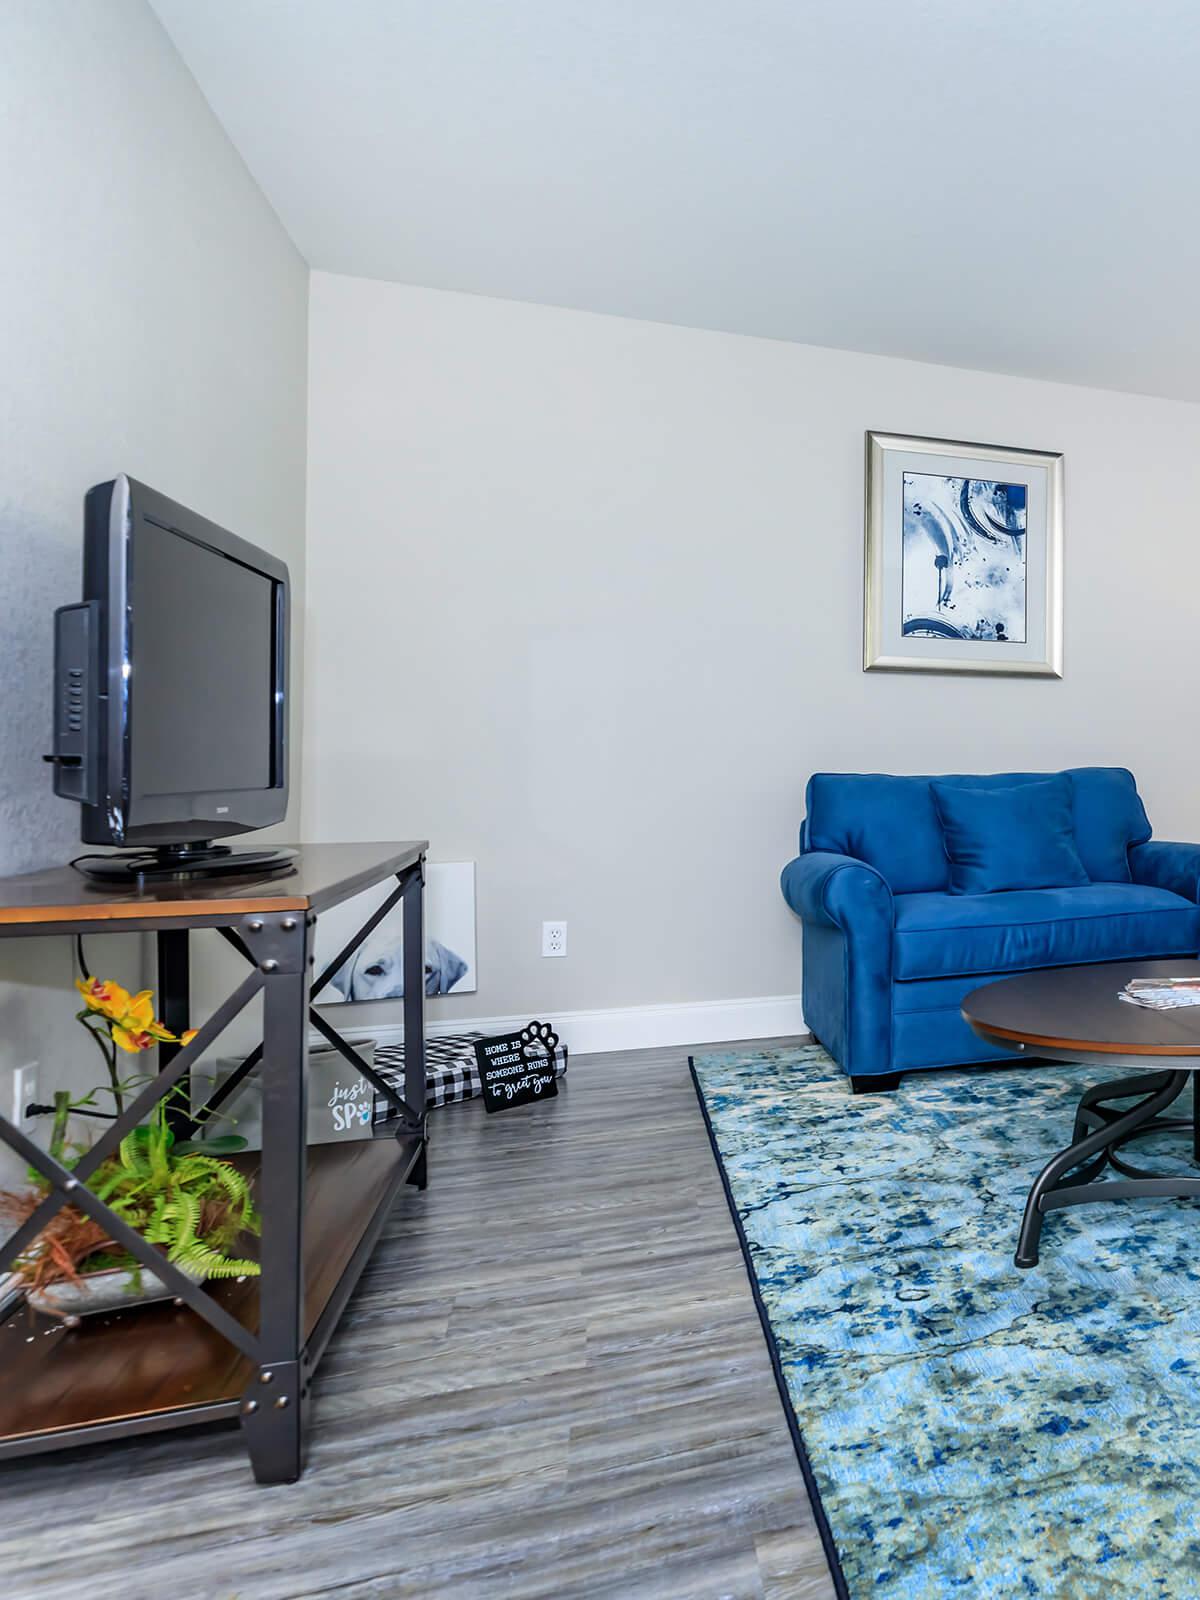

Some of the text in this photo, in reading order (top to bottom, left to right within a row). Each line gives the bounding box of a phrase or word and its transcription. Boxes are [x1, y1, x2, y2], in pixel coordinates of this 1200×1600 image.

[485, 1040, 522, 1056] HOME IS
[486, 1059, 549, 1080] SOMEONE RUNS
[490, 1053, 521, 1066] WHERE
[327, 1076, 369, 1107] just
[488, 1074, 553, 1099] to greet you
